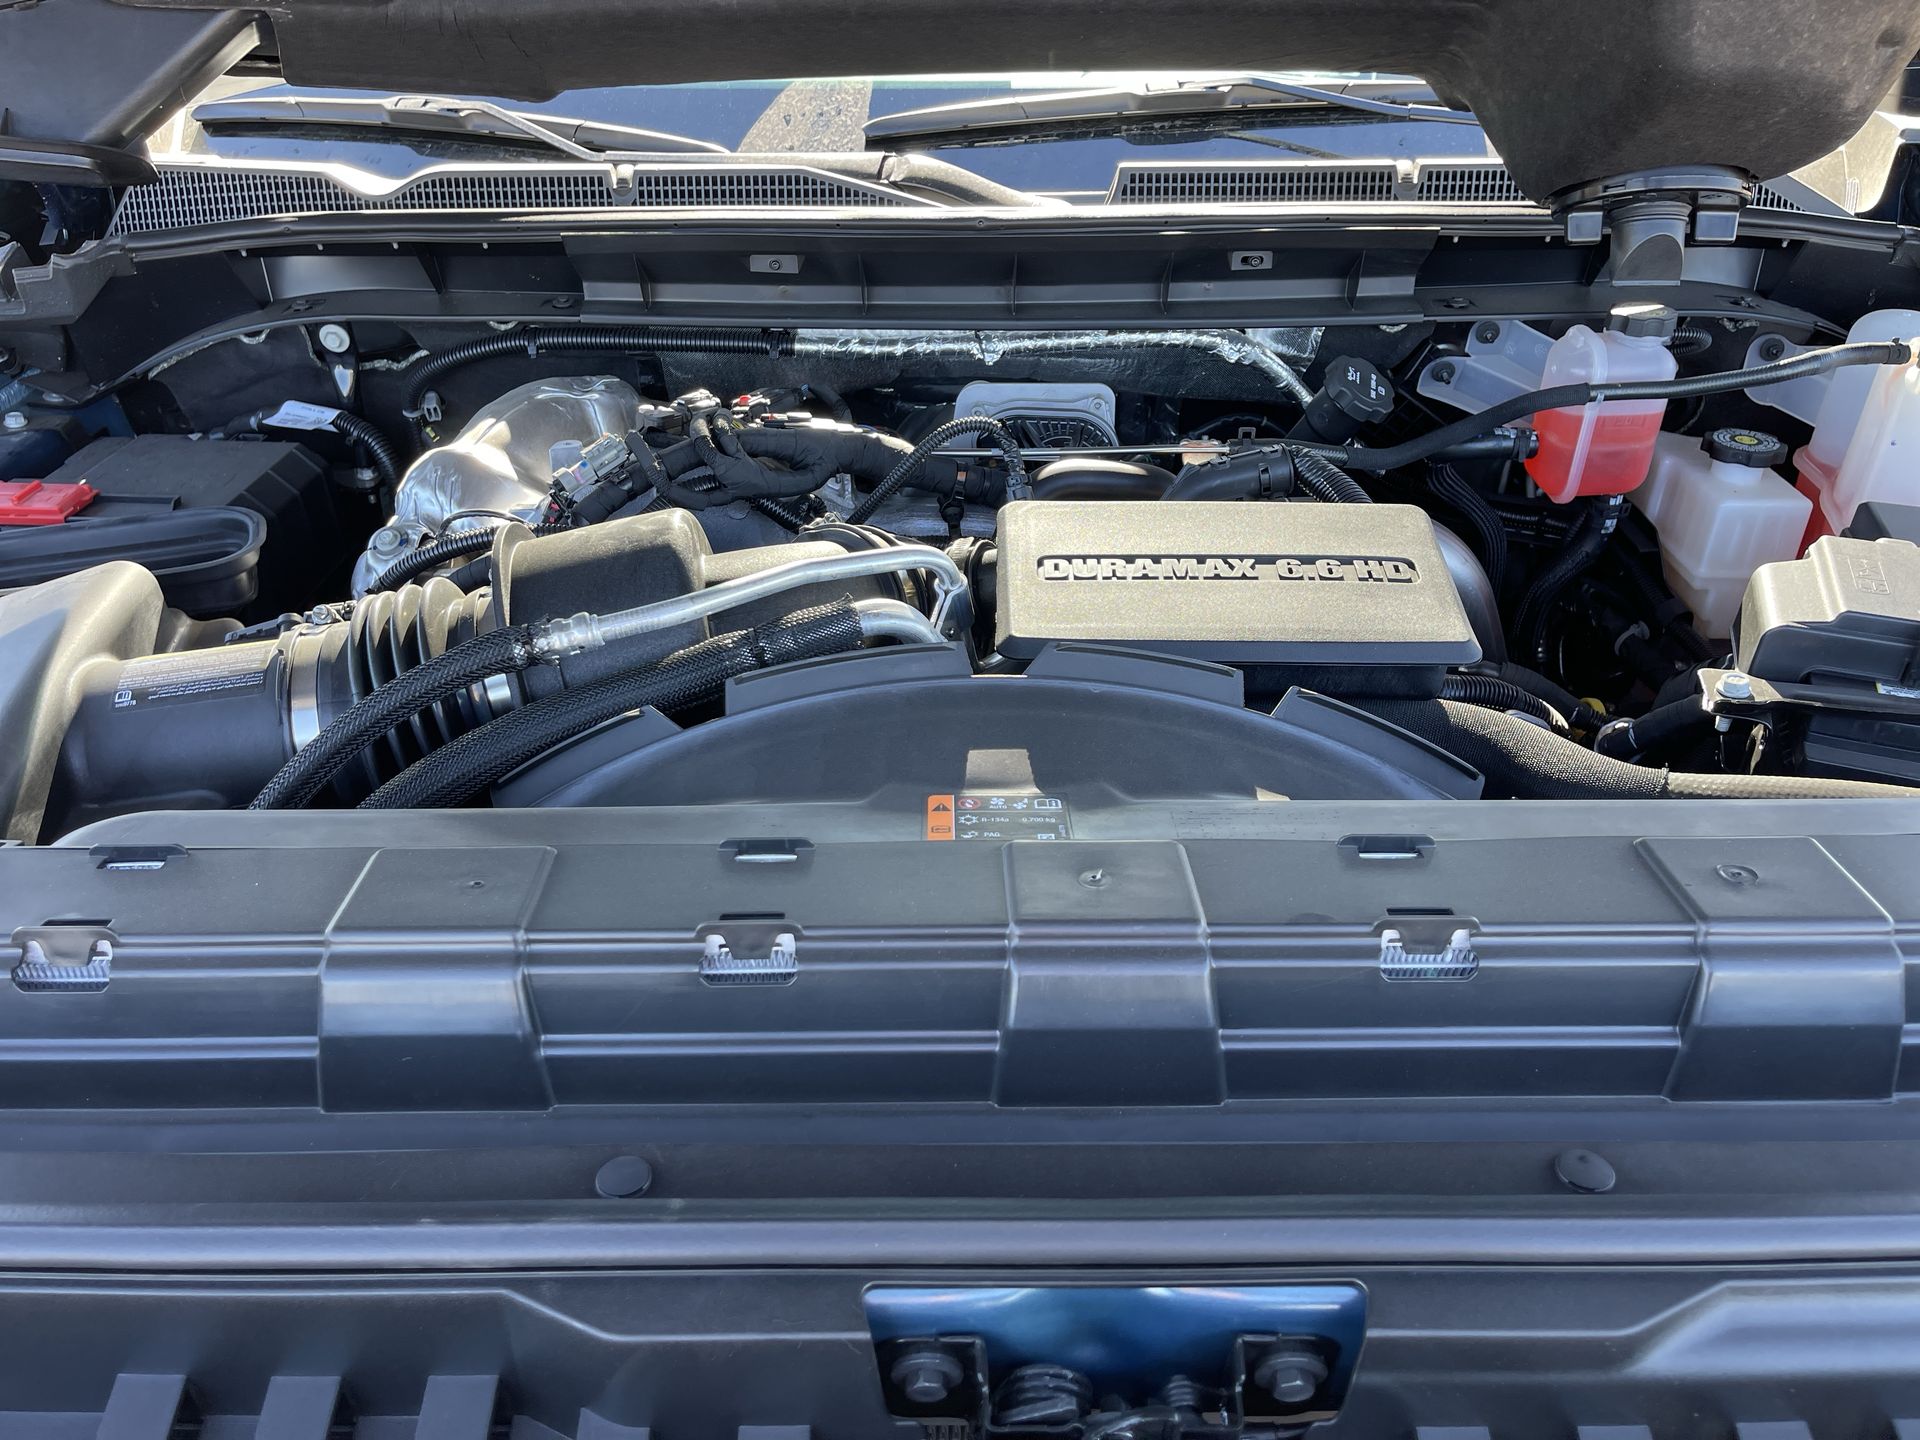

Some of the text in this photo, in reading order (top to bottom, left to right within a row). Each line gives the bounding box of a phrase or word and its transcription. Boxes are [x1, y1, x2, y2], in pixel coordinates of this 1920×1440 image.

[1043, 558, 1412, 583] DURAMAX 6.6 HD
